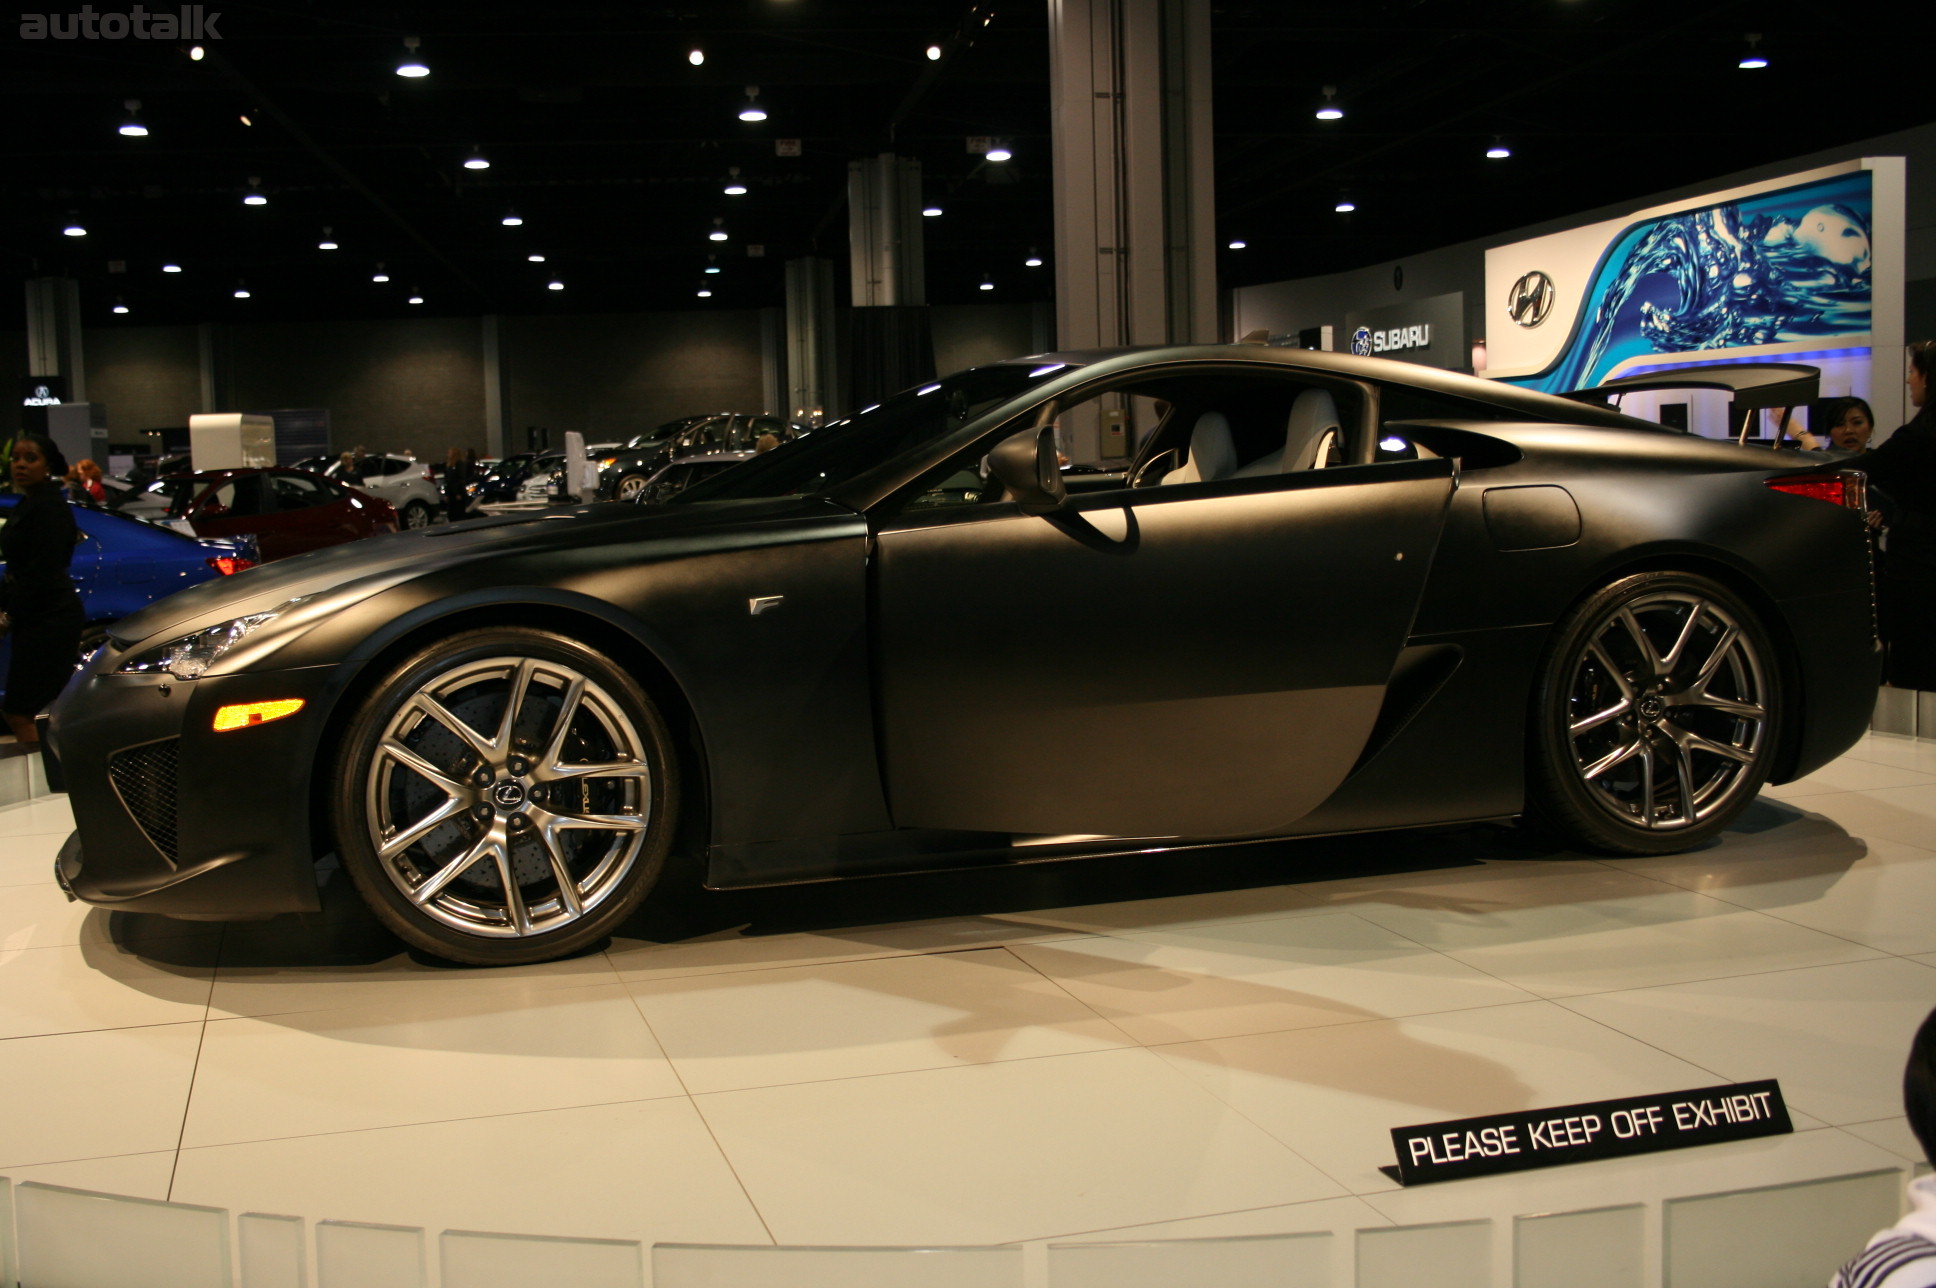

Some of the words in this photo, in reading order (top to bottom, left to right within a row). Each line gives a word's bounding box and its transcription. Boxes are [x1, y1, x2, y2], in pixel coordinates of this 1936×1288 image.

[1373, 324, 1429, 352] SUBARU
[24, 397, 61, 406] ACURA
[1408, 1125, 1520, 1166] PLEASE
[1528, 1114, 1602, 1150] KEEP
[1610, 1106, 1664, 1138] OFF
[1672, 1091, 1772, 1131] EXHIBIT
